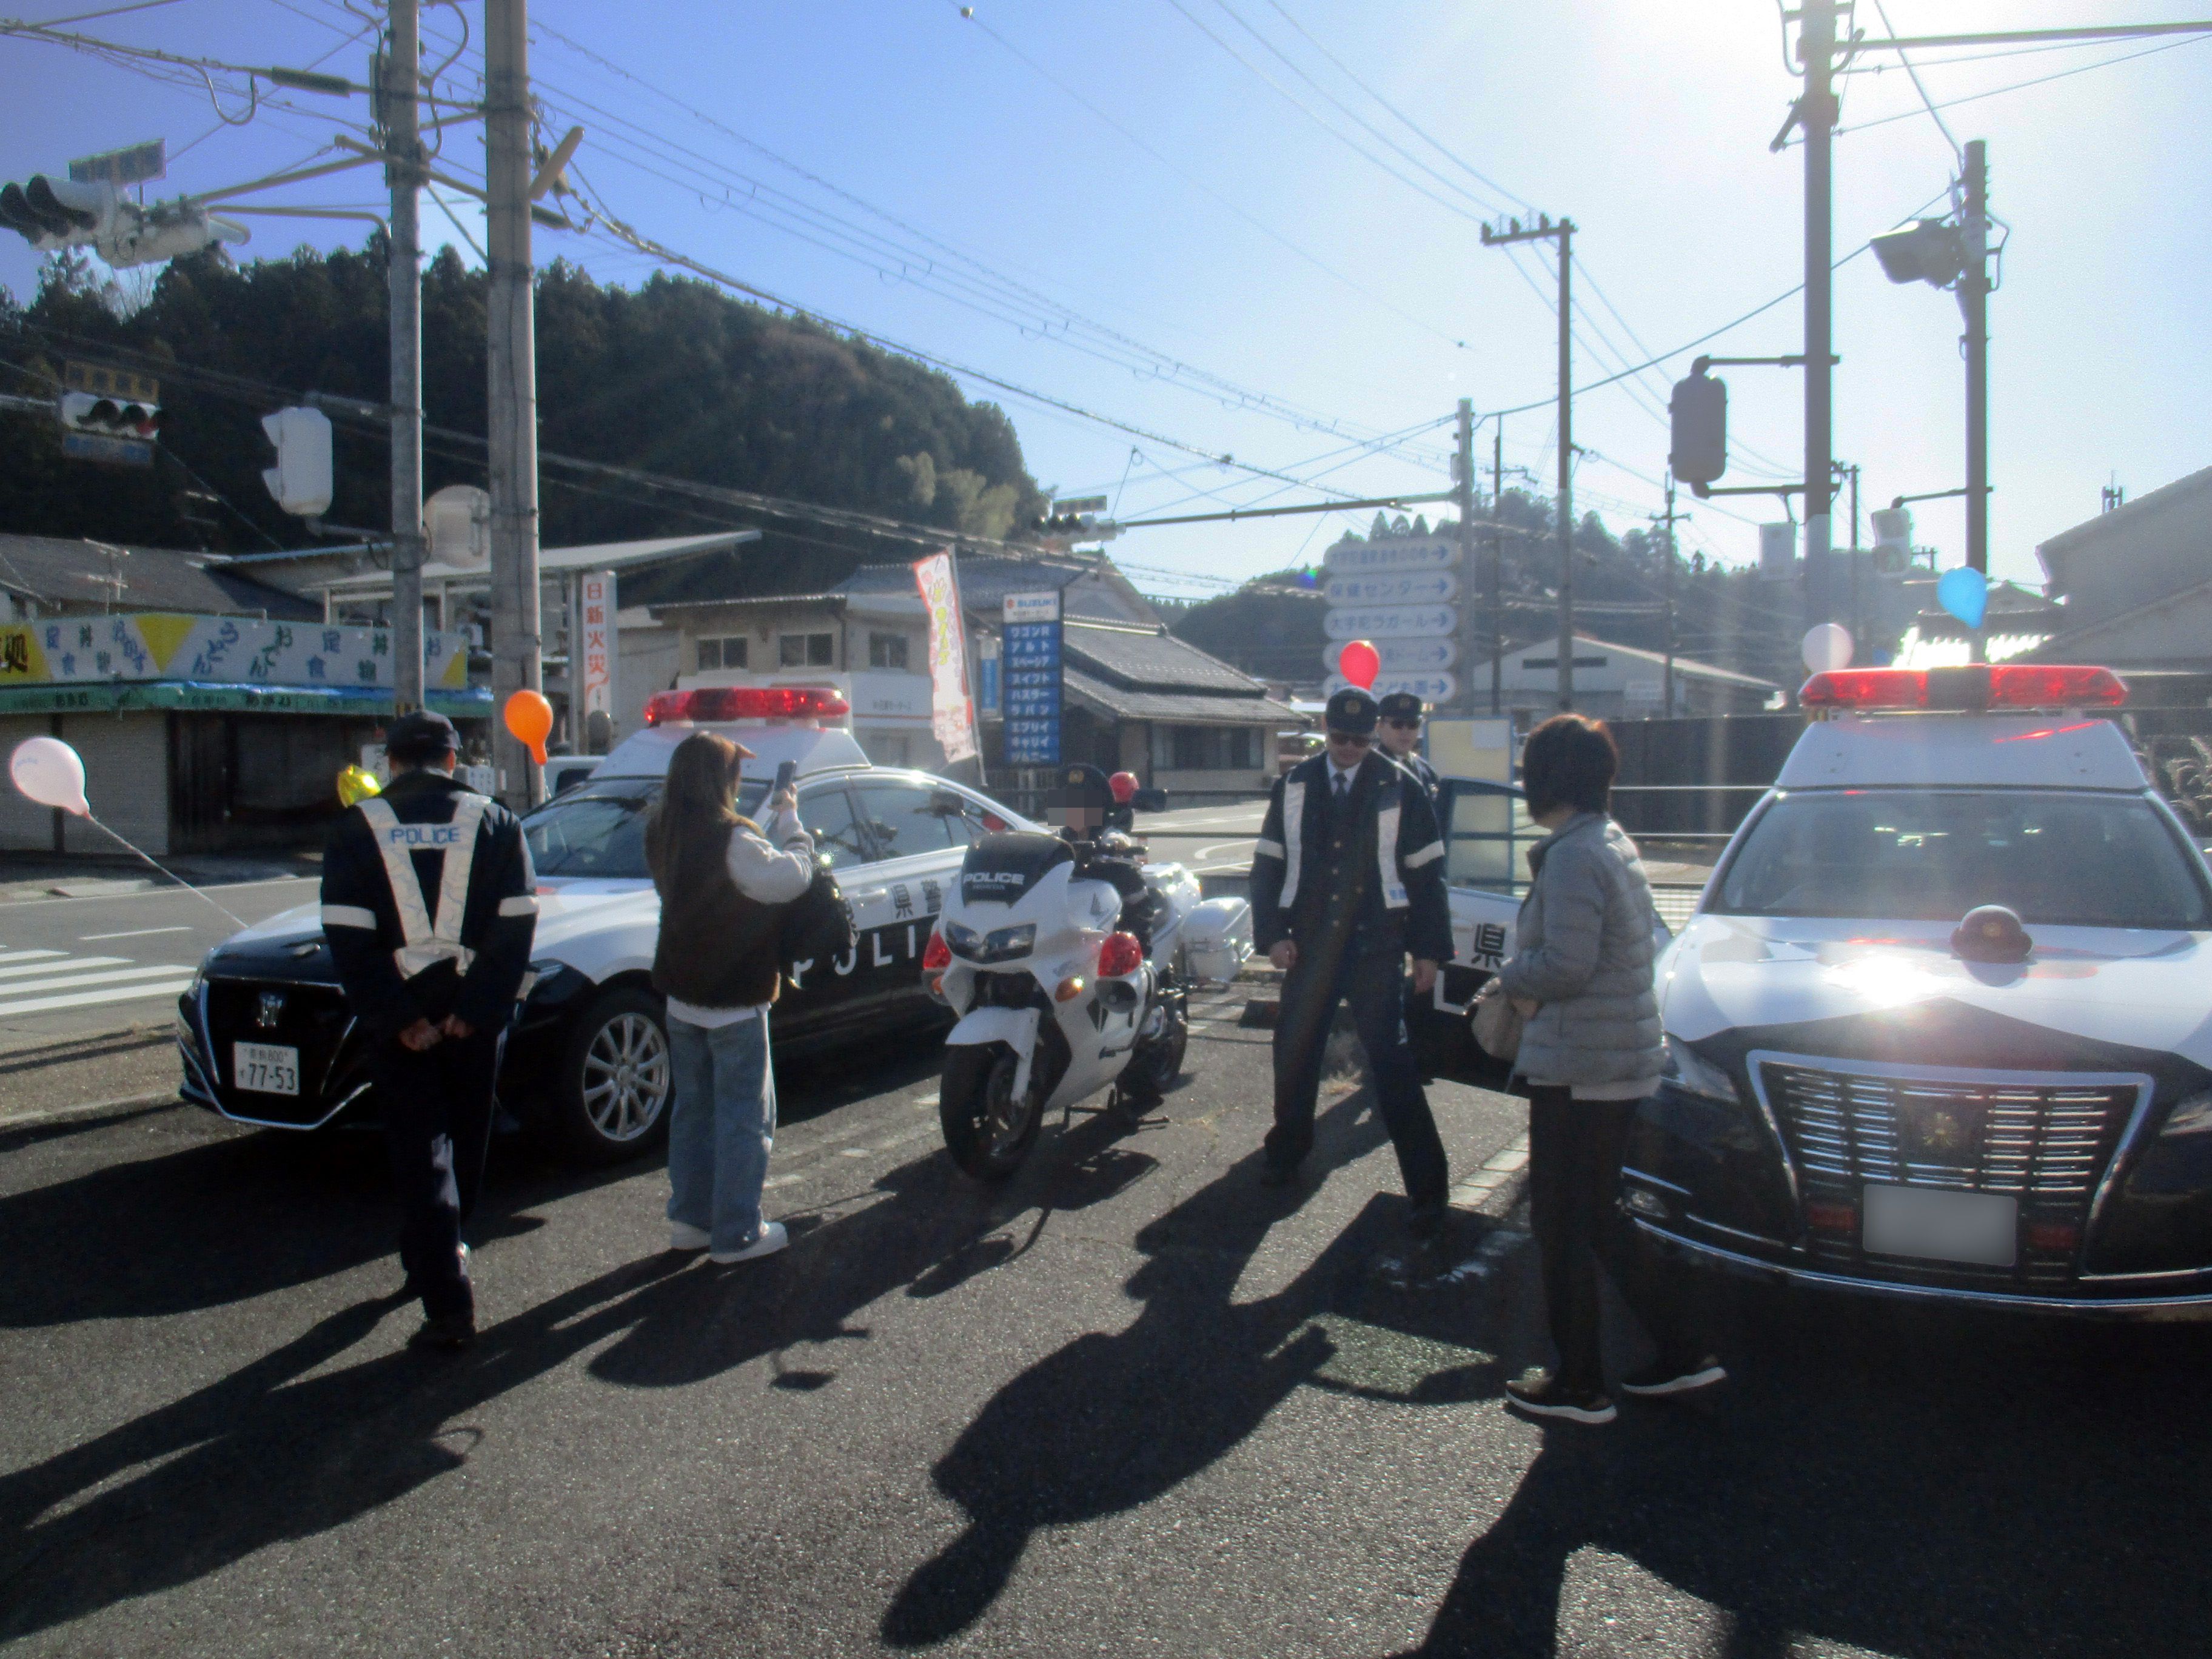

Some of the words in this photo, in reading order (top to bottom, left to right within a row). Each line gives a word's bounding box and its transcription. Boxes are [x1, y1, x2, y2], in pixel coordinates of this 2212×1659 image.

[1330, 580, 1429, 597] 保健センター
[1017, 598, 1059, 607] SUZUKI
[587, 582, 605, 674] 日新火災
[1332, 614, 1427, 631] 大宇陀ラガール
[1011, 625, 1050, 638] ワゴンR
[0, 632, 28, 674] 処
[192, 620, 240, 674] うどん
[249, 625, 293, 677] おでん
[1011, 640, 1050, 653] アルト
[1012, 672, 1050, 684] スイフト
[1012, 689, 1050, 700] ハスラー
[1332, 680, 1429, 697] 大こども園
[1011, 703, 1049, 716] ラパン
[390, 827, 460, 844] POLICE
[963, 872, 1025, 885] POLICE
[1471, 922, 1506, 968] 県
[249, 1062, 295, 1090] 77-53
